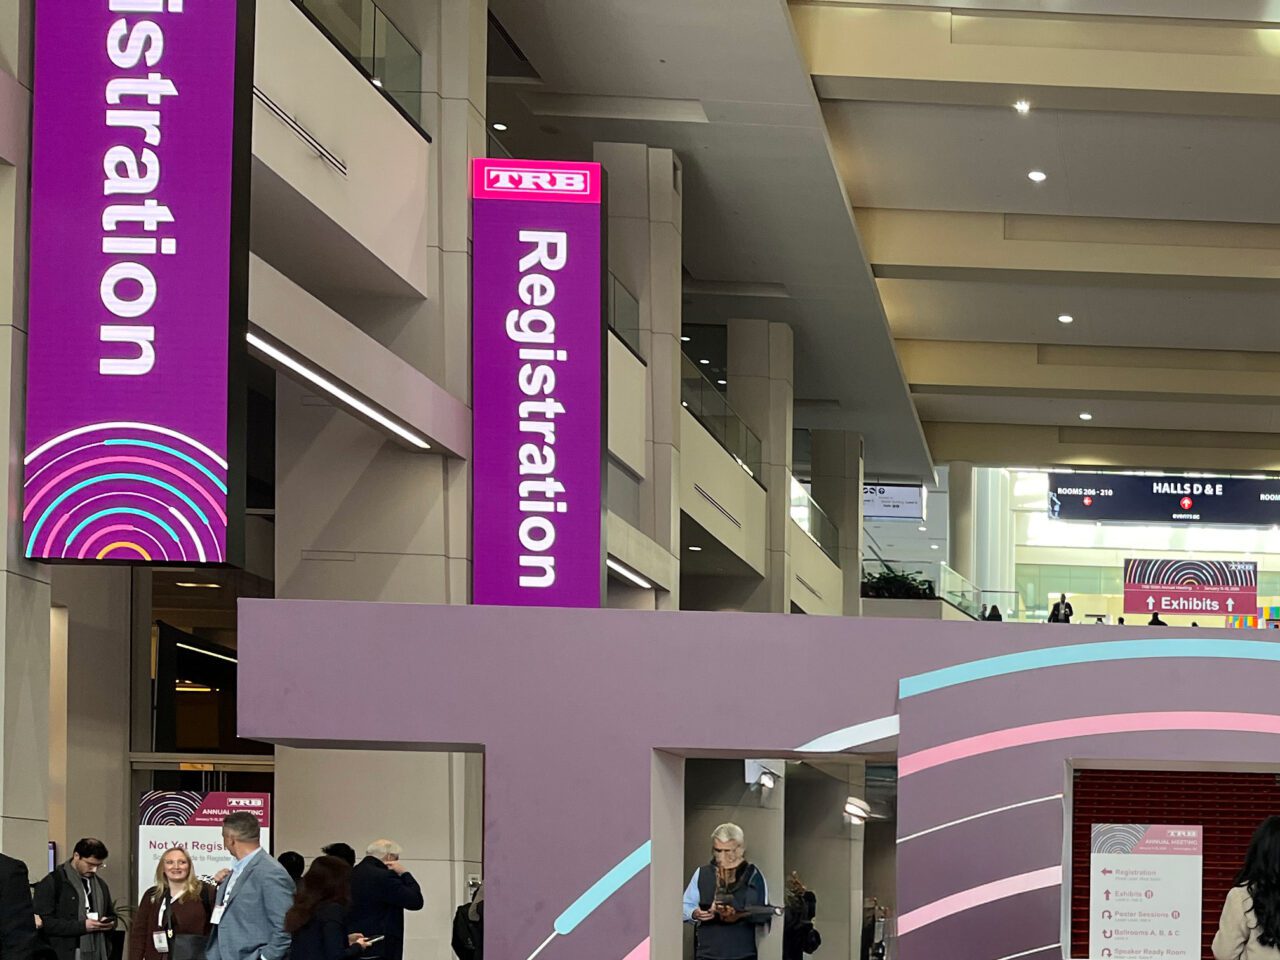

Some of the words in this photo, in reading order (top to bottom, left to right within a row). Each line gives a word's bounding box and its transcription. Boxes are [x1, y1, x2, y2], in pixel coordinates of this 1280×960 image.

[489, 170, 585, 191] TRB
[505, 229, 568, 588] Registration
[1057, 487, 1083, 496] ROOMS
[1152, 482, 1191, 494] HALLS
[1193, 484, 1203, 495] D
[1204, 484, 1214, 495] &
[1215, 484, 1224, 496] E
[1161, 596, 1220, 611] Exhibits
[228, 798, 263, 807] TRB
[149, 840, 168, 850] Not
[171, 841, 188, 850] Yet
[1115, 869, 1157, 877] Registration
